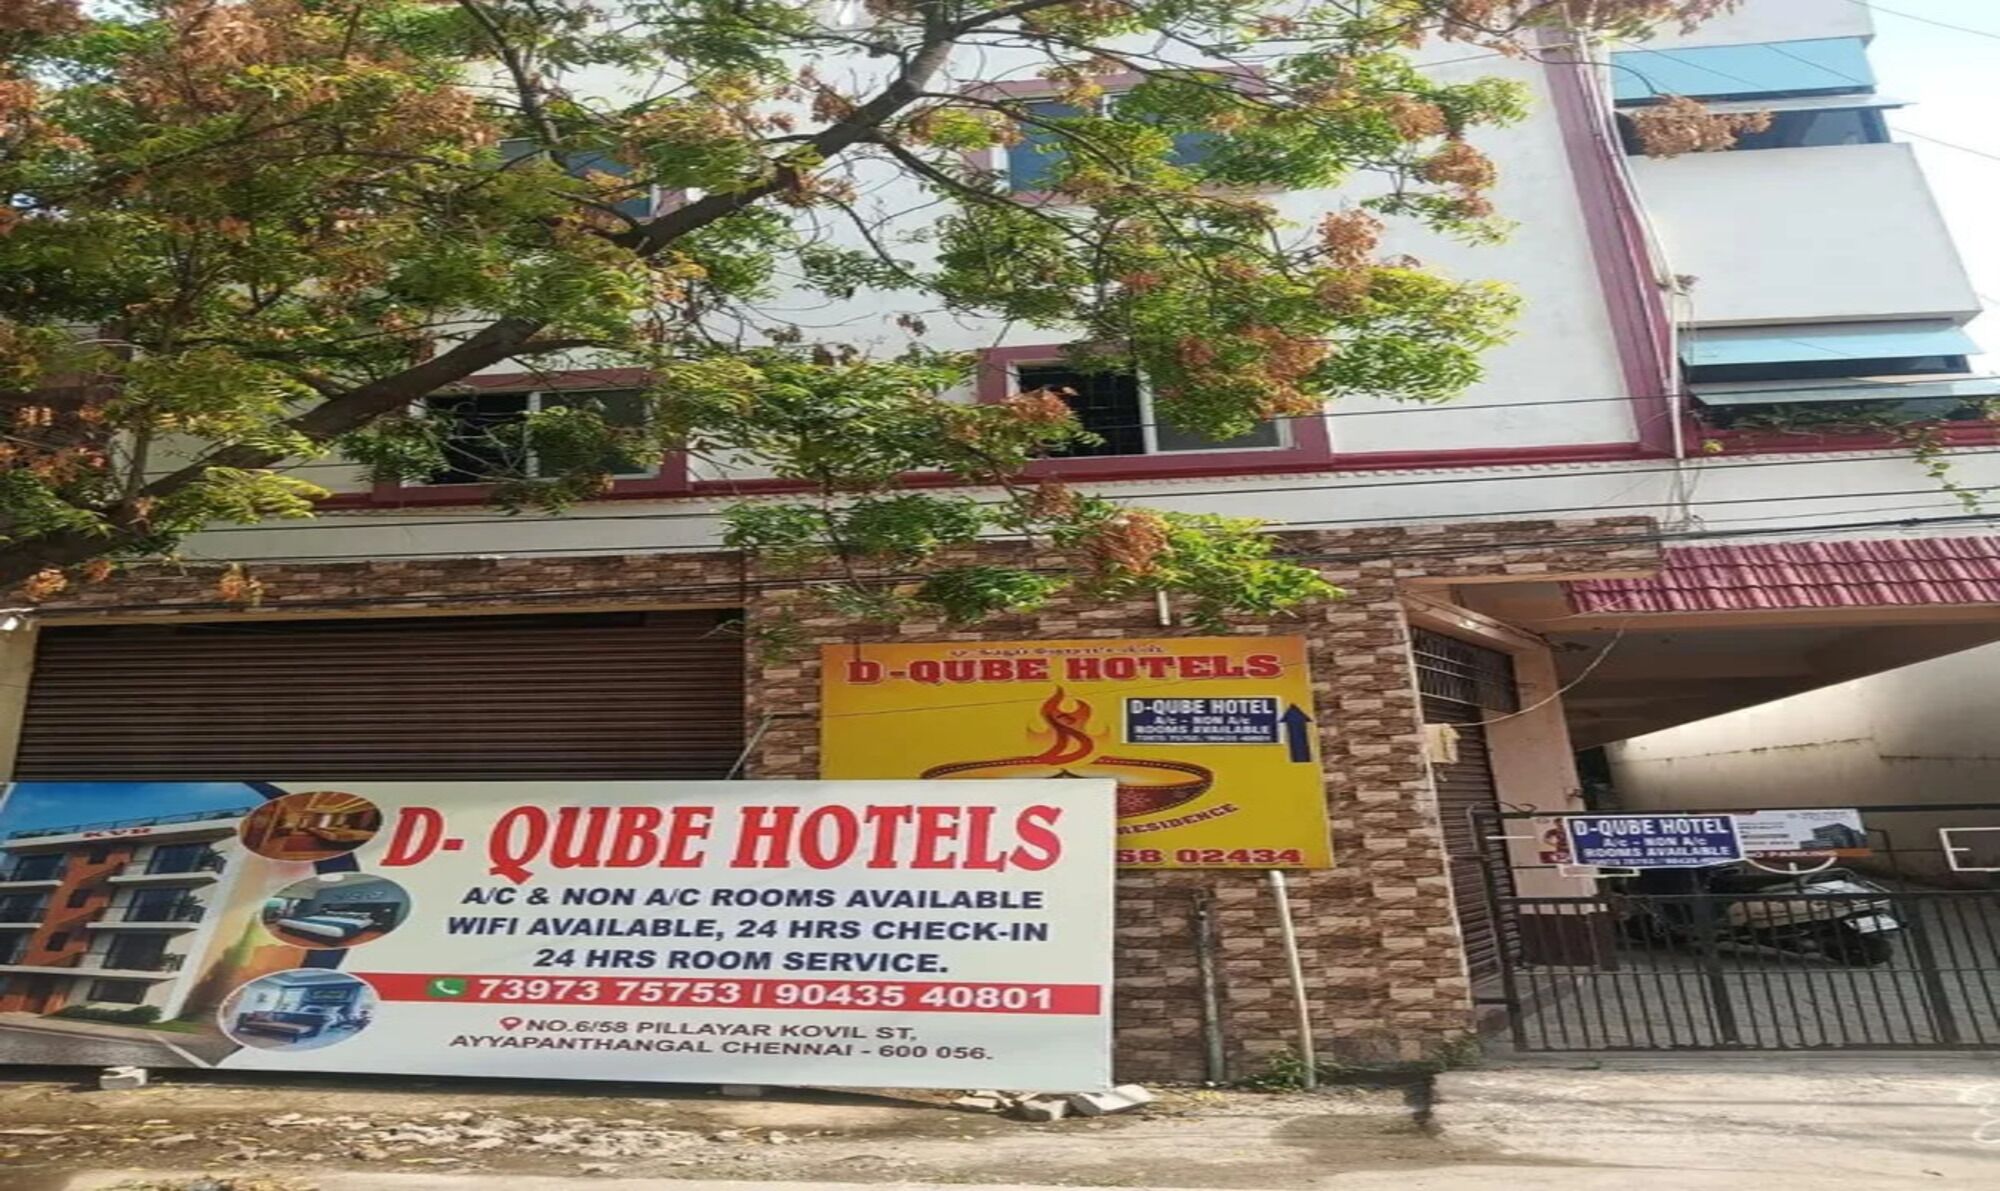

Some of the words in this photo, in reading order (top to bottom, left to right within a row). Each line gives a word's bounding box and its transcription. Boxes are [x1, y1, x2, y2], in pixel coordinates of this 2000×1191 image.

[845, 657, 1048, 685] D-QUBE
[1065, 653, 1281, 682] HOTELS
[1130, 699, 1205, 715] D-QUBE
[1210, 699, 1274, 715] HOTEL
[1134, 725, 1188, 734] ROOMS
[1191, 725, 1271, 735] AVAILABLE
[1192, 716, 1224, 725] NON
[1117, 803, 1240, 836] RESIDENCE
[1573, 819, 1655, 838] D-QUBE
[1660, 817, 1730, 836] HOTEL
[488, 804, 714, 885] QUBE
[729, 804, 1063, 872] HOTELS
[1585, 848, 1643, 858] ROOMS
[1646, 846, 1731, 857] AVAILABLE
[1644, 837, 1679, 847] NON
[1175, 848, 1303, 863] 02434
[461, 887, 517, 905] A/C
[526, 887, 550, 906] &
[562, 888, 635, 906] NON
[645, 888, 701, 907] A/C
[711, 888, 836, 908] ROOMS
[845, 890, 1044, 909] AVAILABLE
[447, 916, 518, 936] WIFI
[526, 918, 725, 941] AVAILABLE,
[736, 919, 778, 938] 24
[788, 920, 861, 939] HRS
[872, 920, 1049, 942] CHECK-IN
[533, 949, 576, 968] 24
[585, 949, 657, 969] HRS
[667, 950, 772, 971] ROOM
[782, 951, 949, 973] SERVICE.
[477, 978, 601, 1001] 73973
[615, 980, 742, 1004] 75753
[775, 983, 906, 1007] 90435
[919, 985, 1052, 1010] 40801
[525, 1018, 629, 1035] NO.6/58
[635, 1021, 772, 1037] PILLAYAR
[779, 1024, 868, 1039] KOVIL
[875, 1025, 918, 1042] ST,
[449, 1033, 714, 1054] AYYAPANTHANGAL
[721, 1040, 853, 1057] CHENNAI
[878, 1044, 928, 1059] 600
[935, 1046, 995, 1061] 056.
